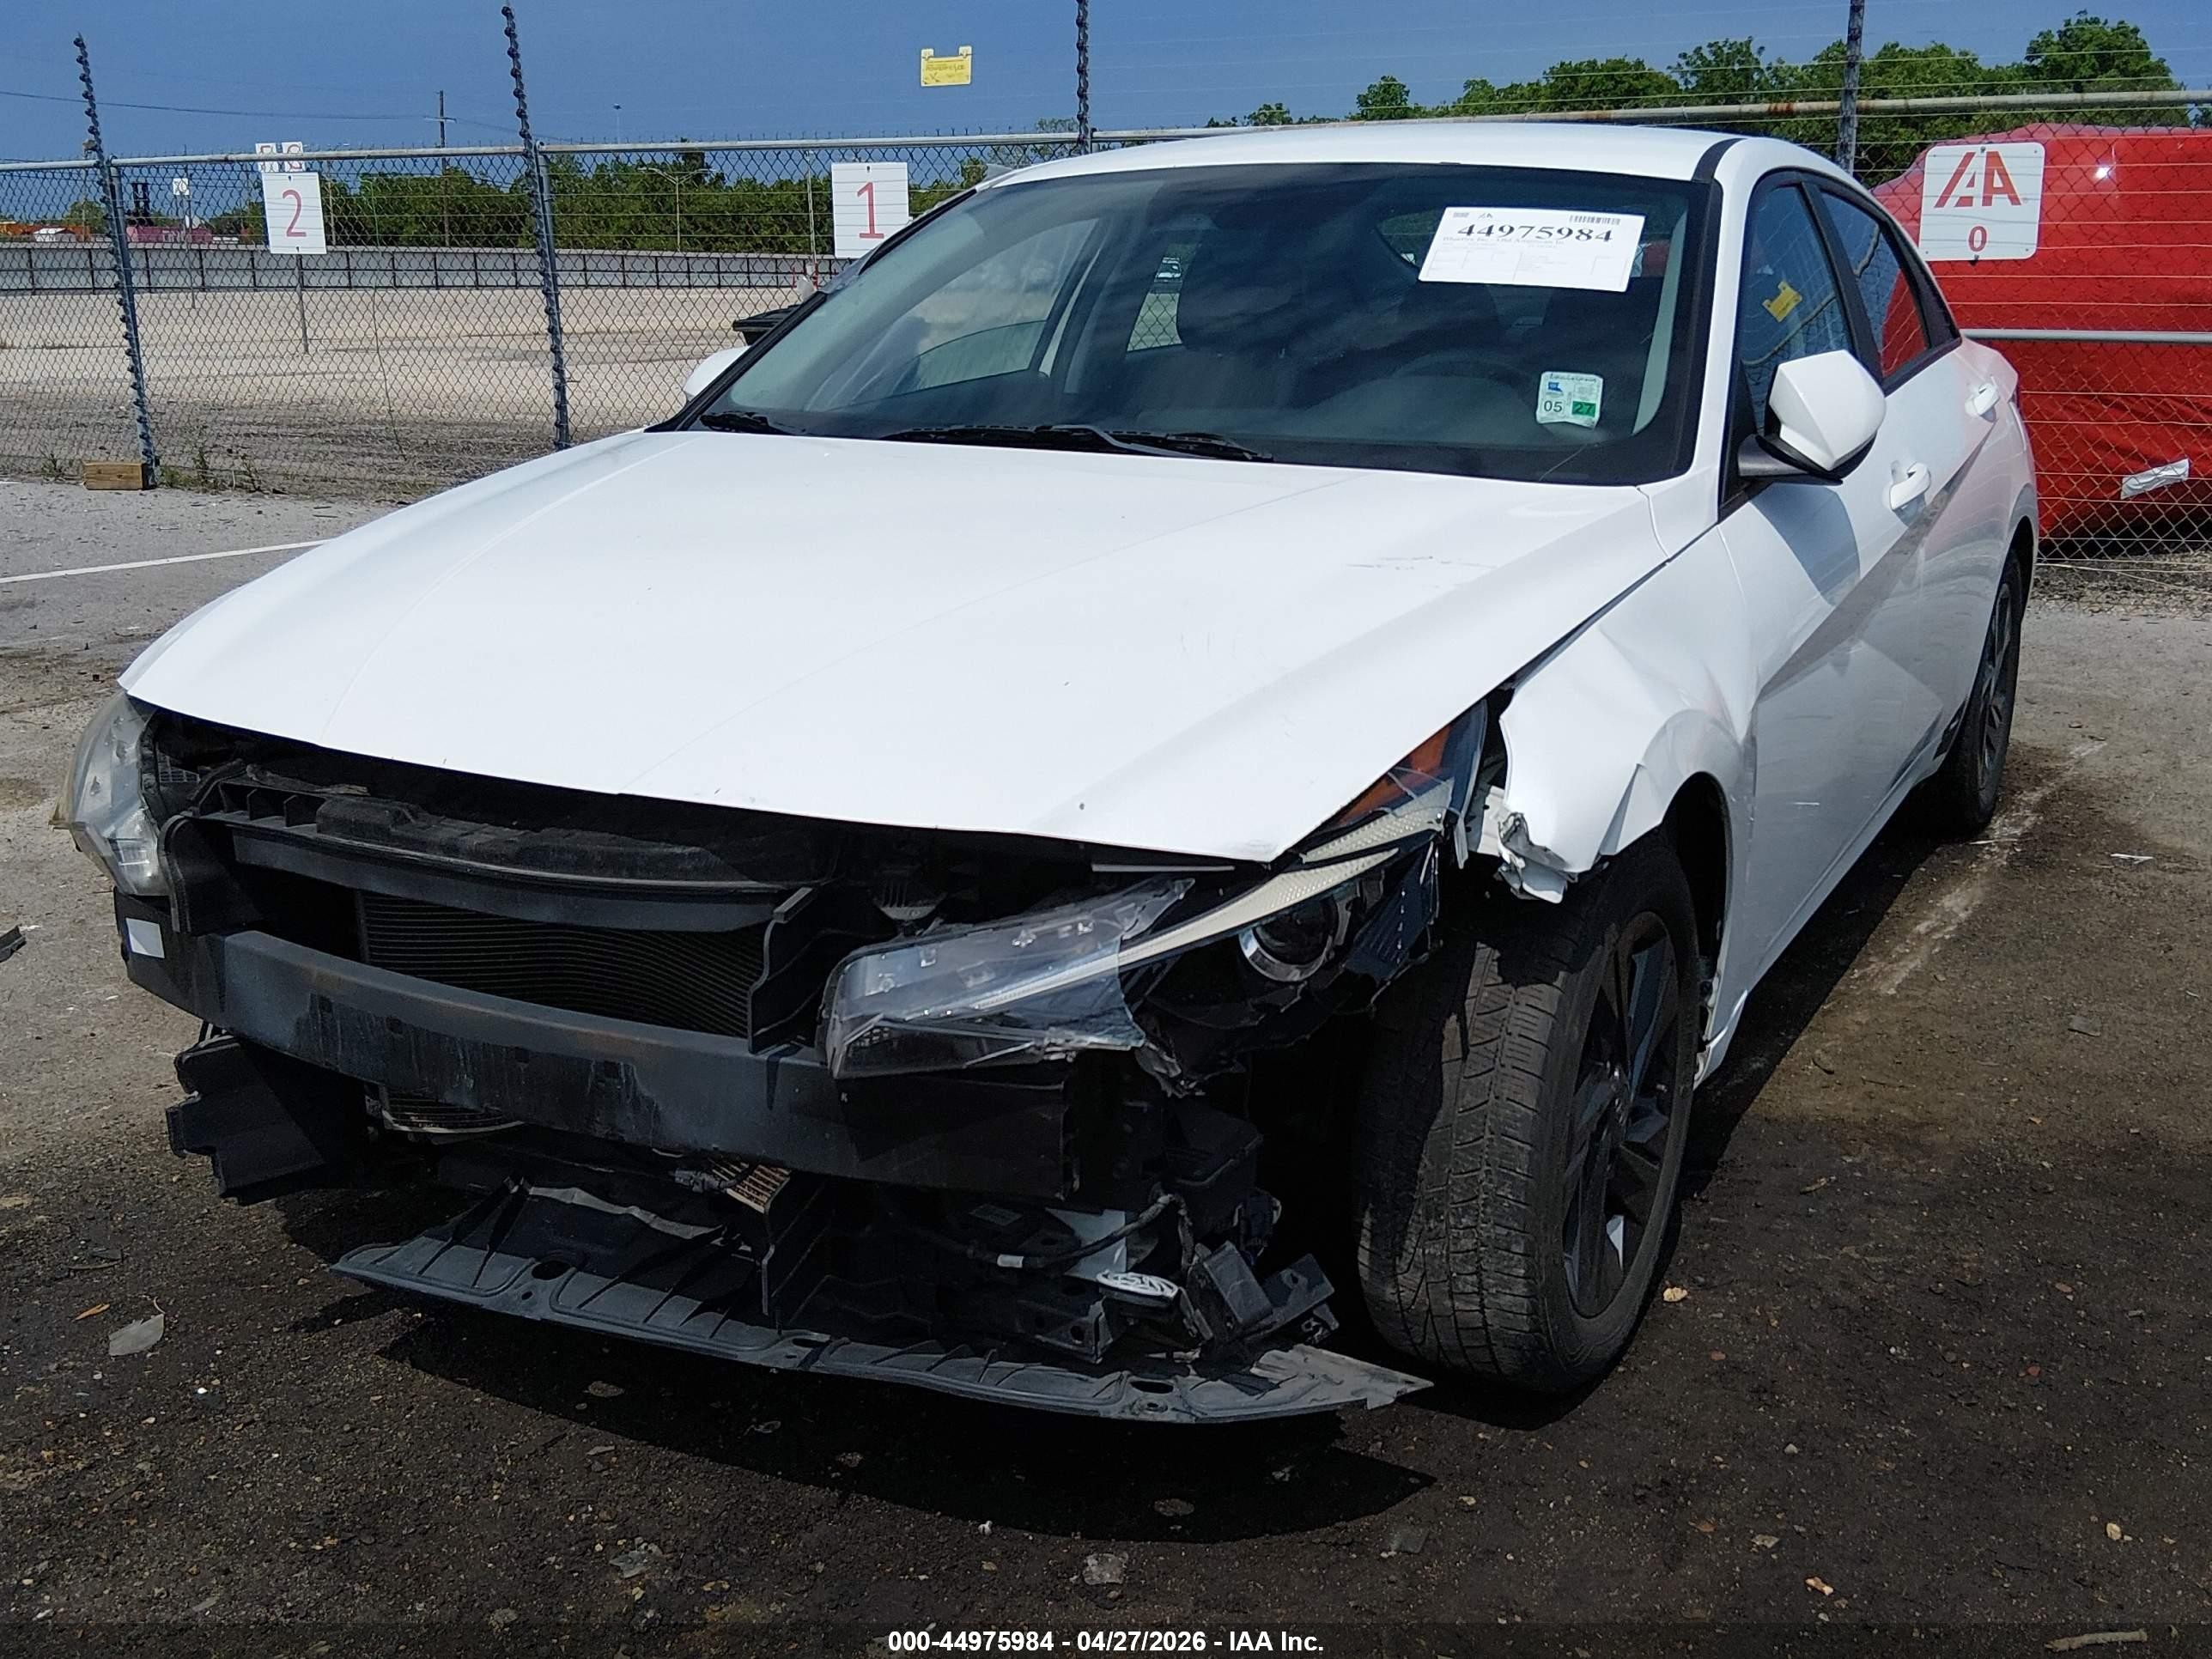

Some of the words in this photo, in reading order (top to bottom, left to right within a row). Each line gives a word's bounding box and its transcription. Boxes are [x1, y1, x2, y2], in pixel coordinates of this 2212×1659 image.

[282, 189, 307, 237] 2
[857, 181, 884, 239] 1
[1457, 223, 1613, 242] 44975984
[1543, 400, 1563, 413] 05
[1575, 403, 1594, 415] 27
